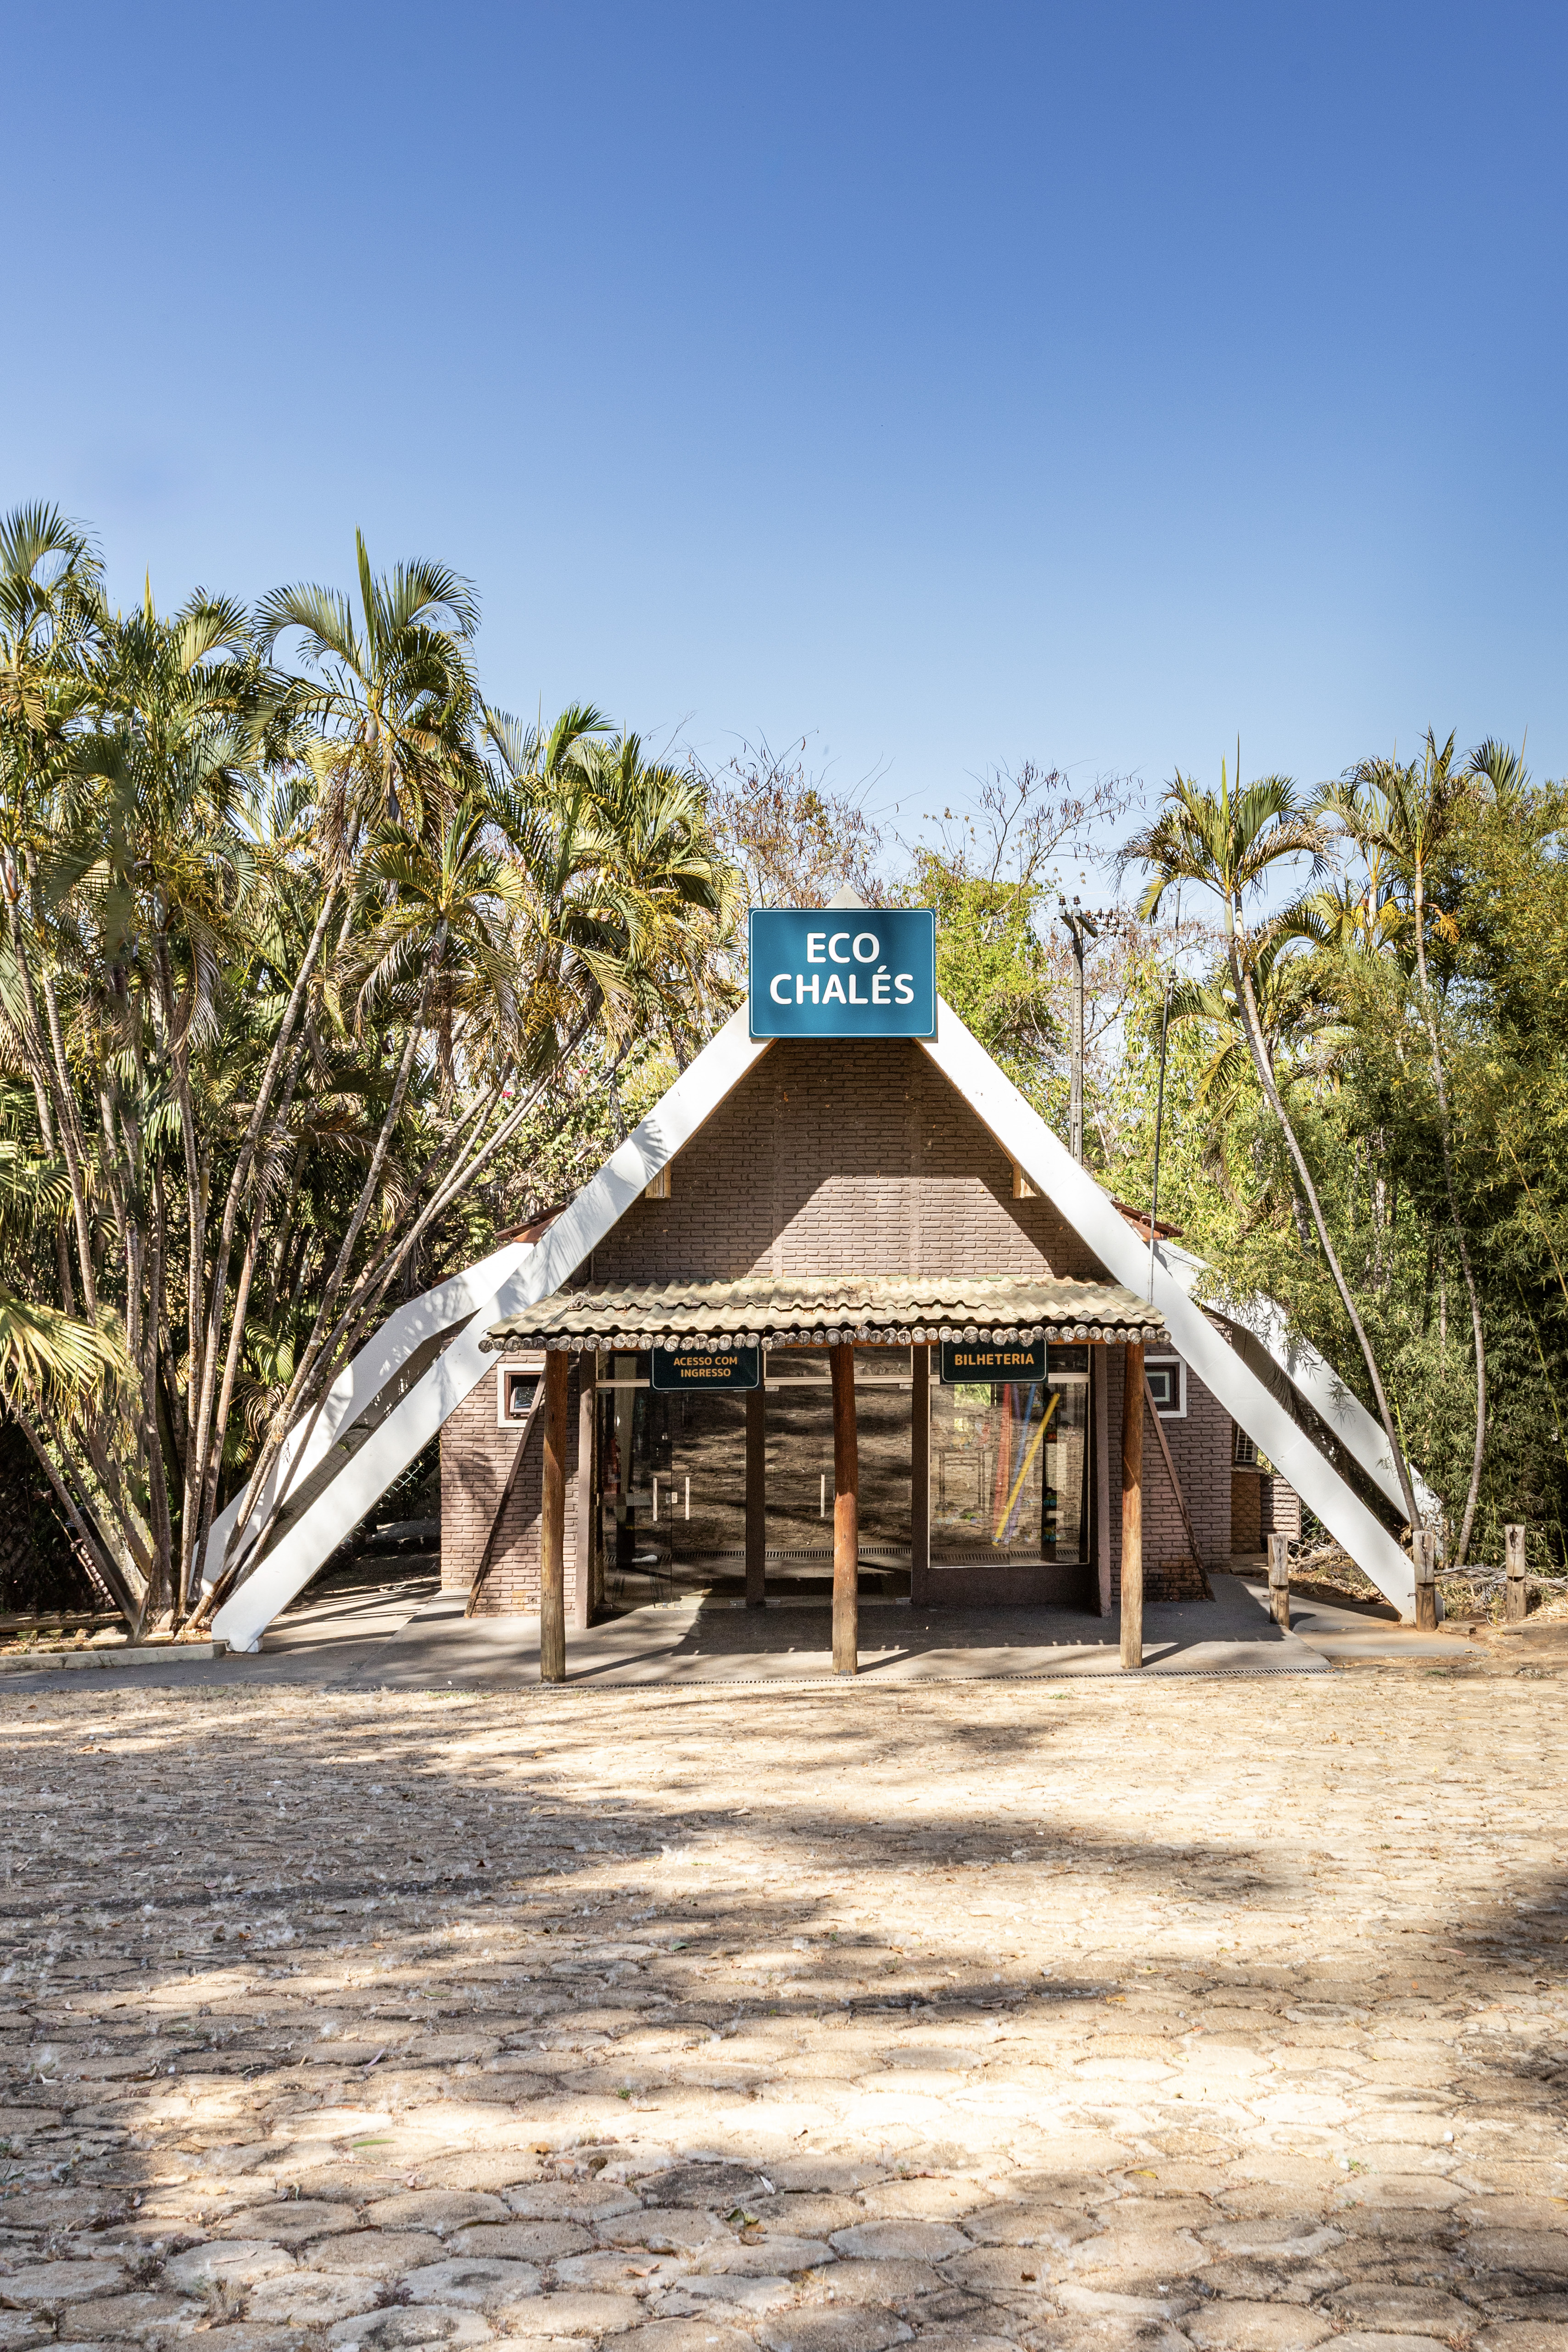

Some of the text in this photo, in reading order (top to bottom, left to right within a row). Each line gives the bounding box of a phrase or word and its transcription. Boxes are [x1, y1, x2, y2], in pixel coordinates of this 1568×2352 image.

[807, 933, 880, 963] ECO
[770, 965, 914, 1004] CHALÉS
[674, 1356, 737, 1365] ACESSO COM
[954, 1354, 1034, 1365] BILHETERIA
[681, 1368, 731, 1377] INGRESSO
